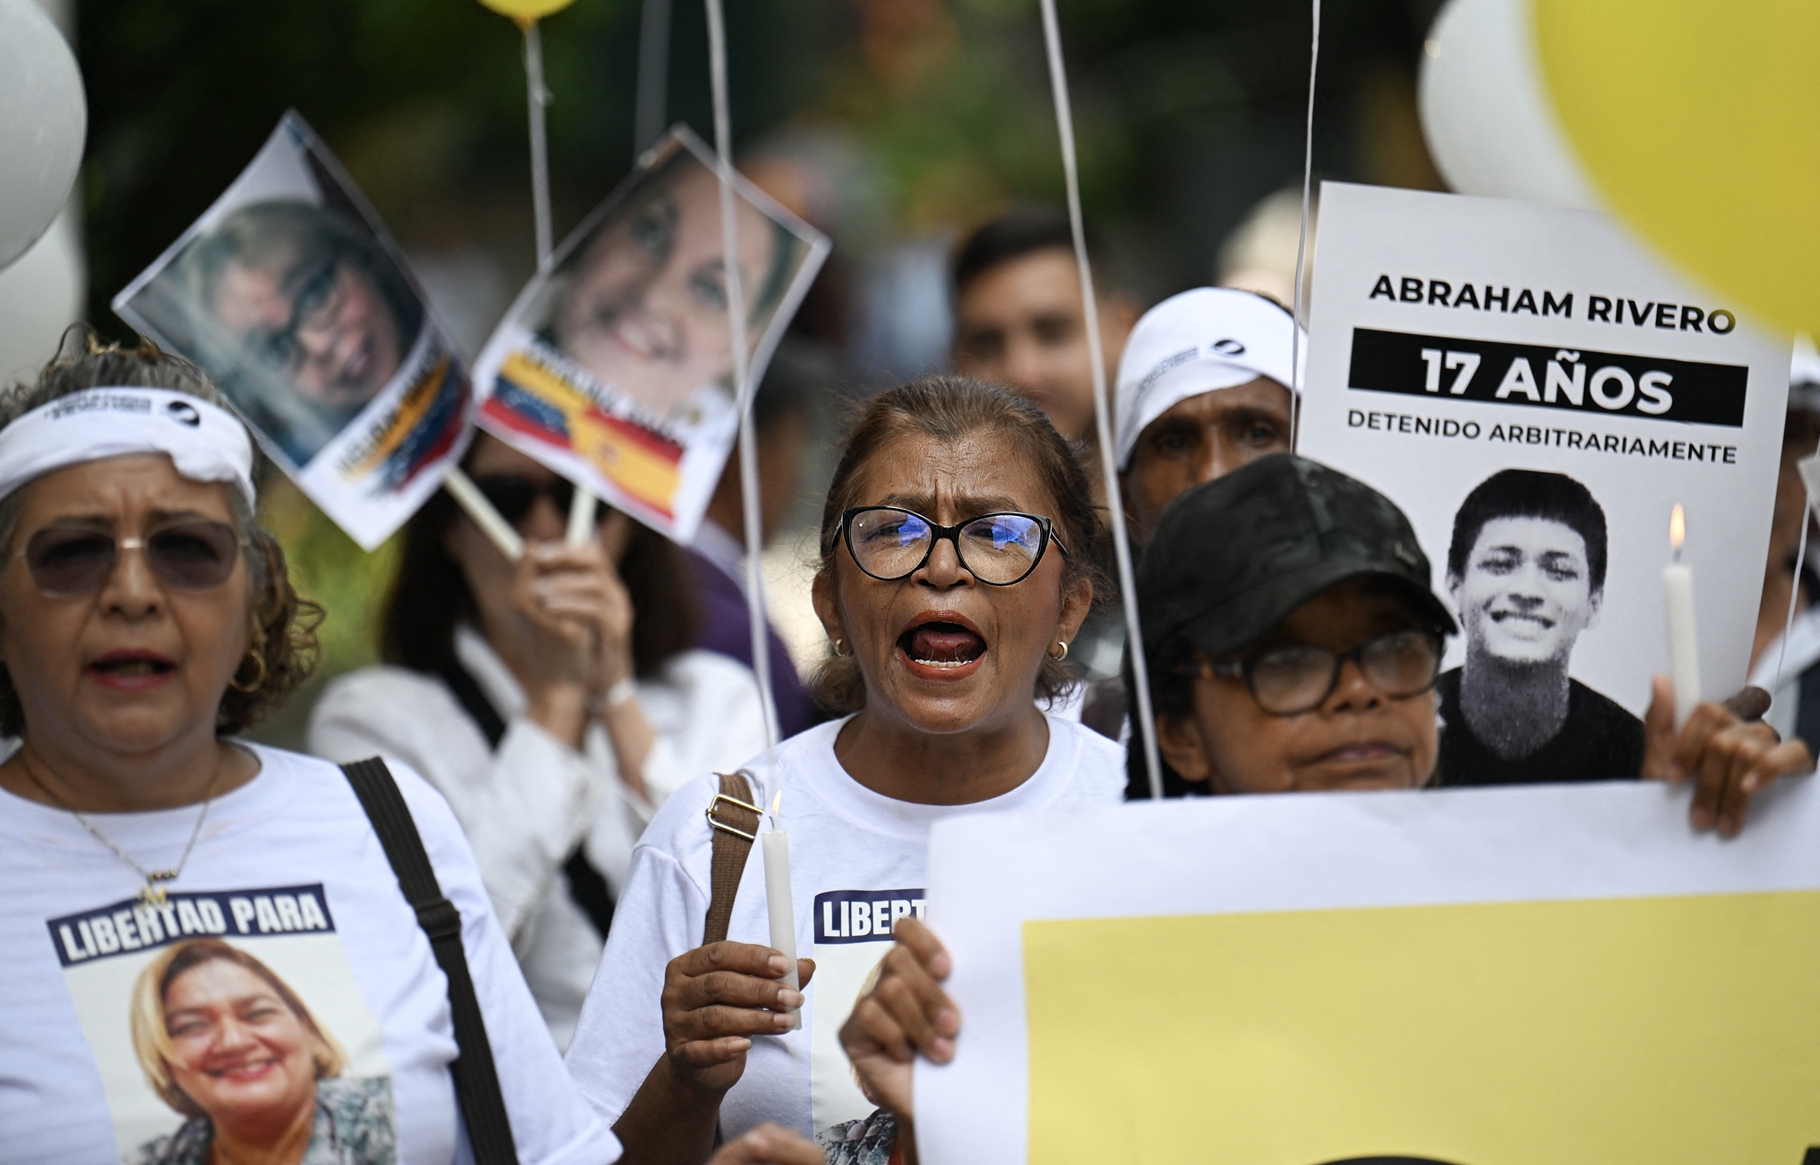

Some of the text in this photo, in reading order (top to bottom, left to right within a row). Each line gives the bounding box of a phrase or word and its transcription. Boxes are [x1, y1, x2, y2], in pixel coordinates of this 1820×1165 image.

[1369, 274, 1737, 335] ABRAHAM RIVERO
[1420, 347, 1674, 415] 17 AÑOS
[1348, 409, 1738, 464] DETENIDO ARBITRARIAMENTE
[58, 891, 328, 962] LIBERTAD PARA
